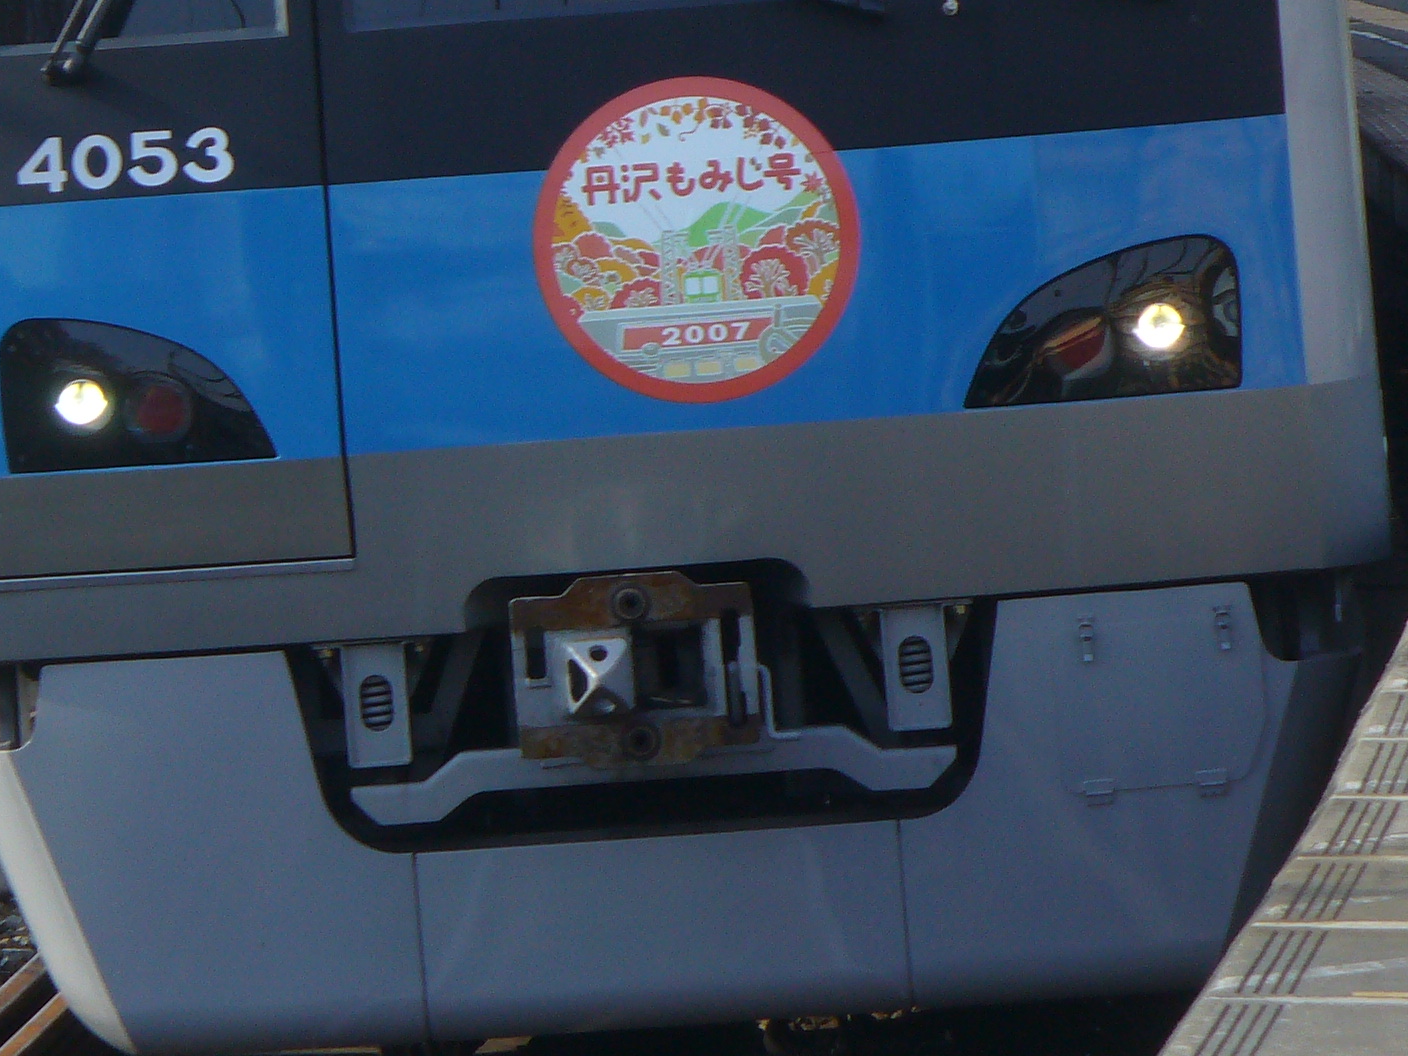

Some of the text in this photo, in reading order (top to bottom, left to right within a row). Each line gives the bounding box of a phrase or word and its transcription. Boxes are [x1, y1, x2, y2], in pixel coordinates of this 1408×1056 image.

[17, 126, 235, 193] 4053
[581, 152, 802, 206] 丹沢もみじ号
[661, 321, 752, 346] 2007
